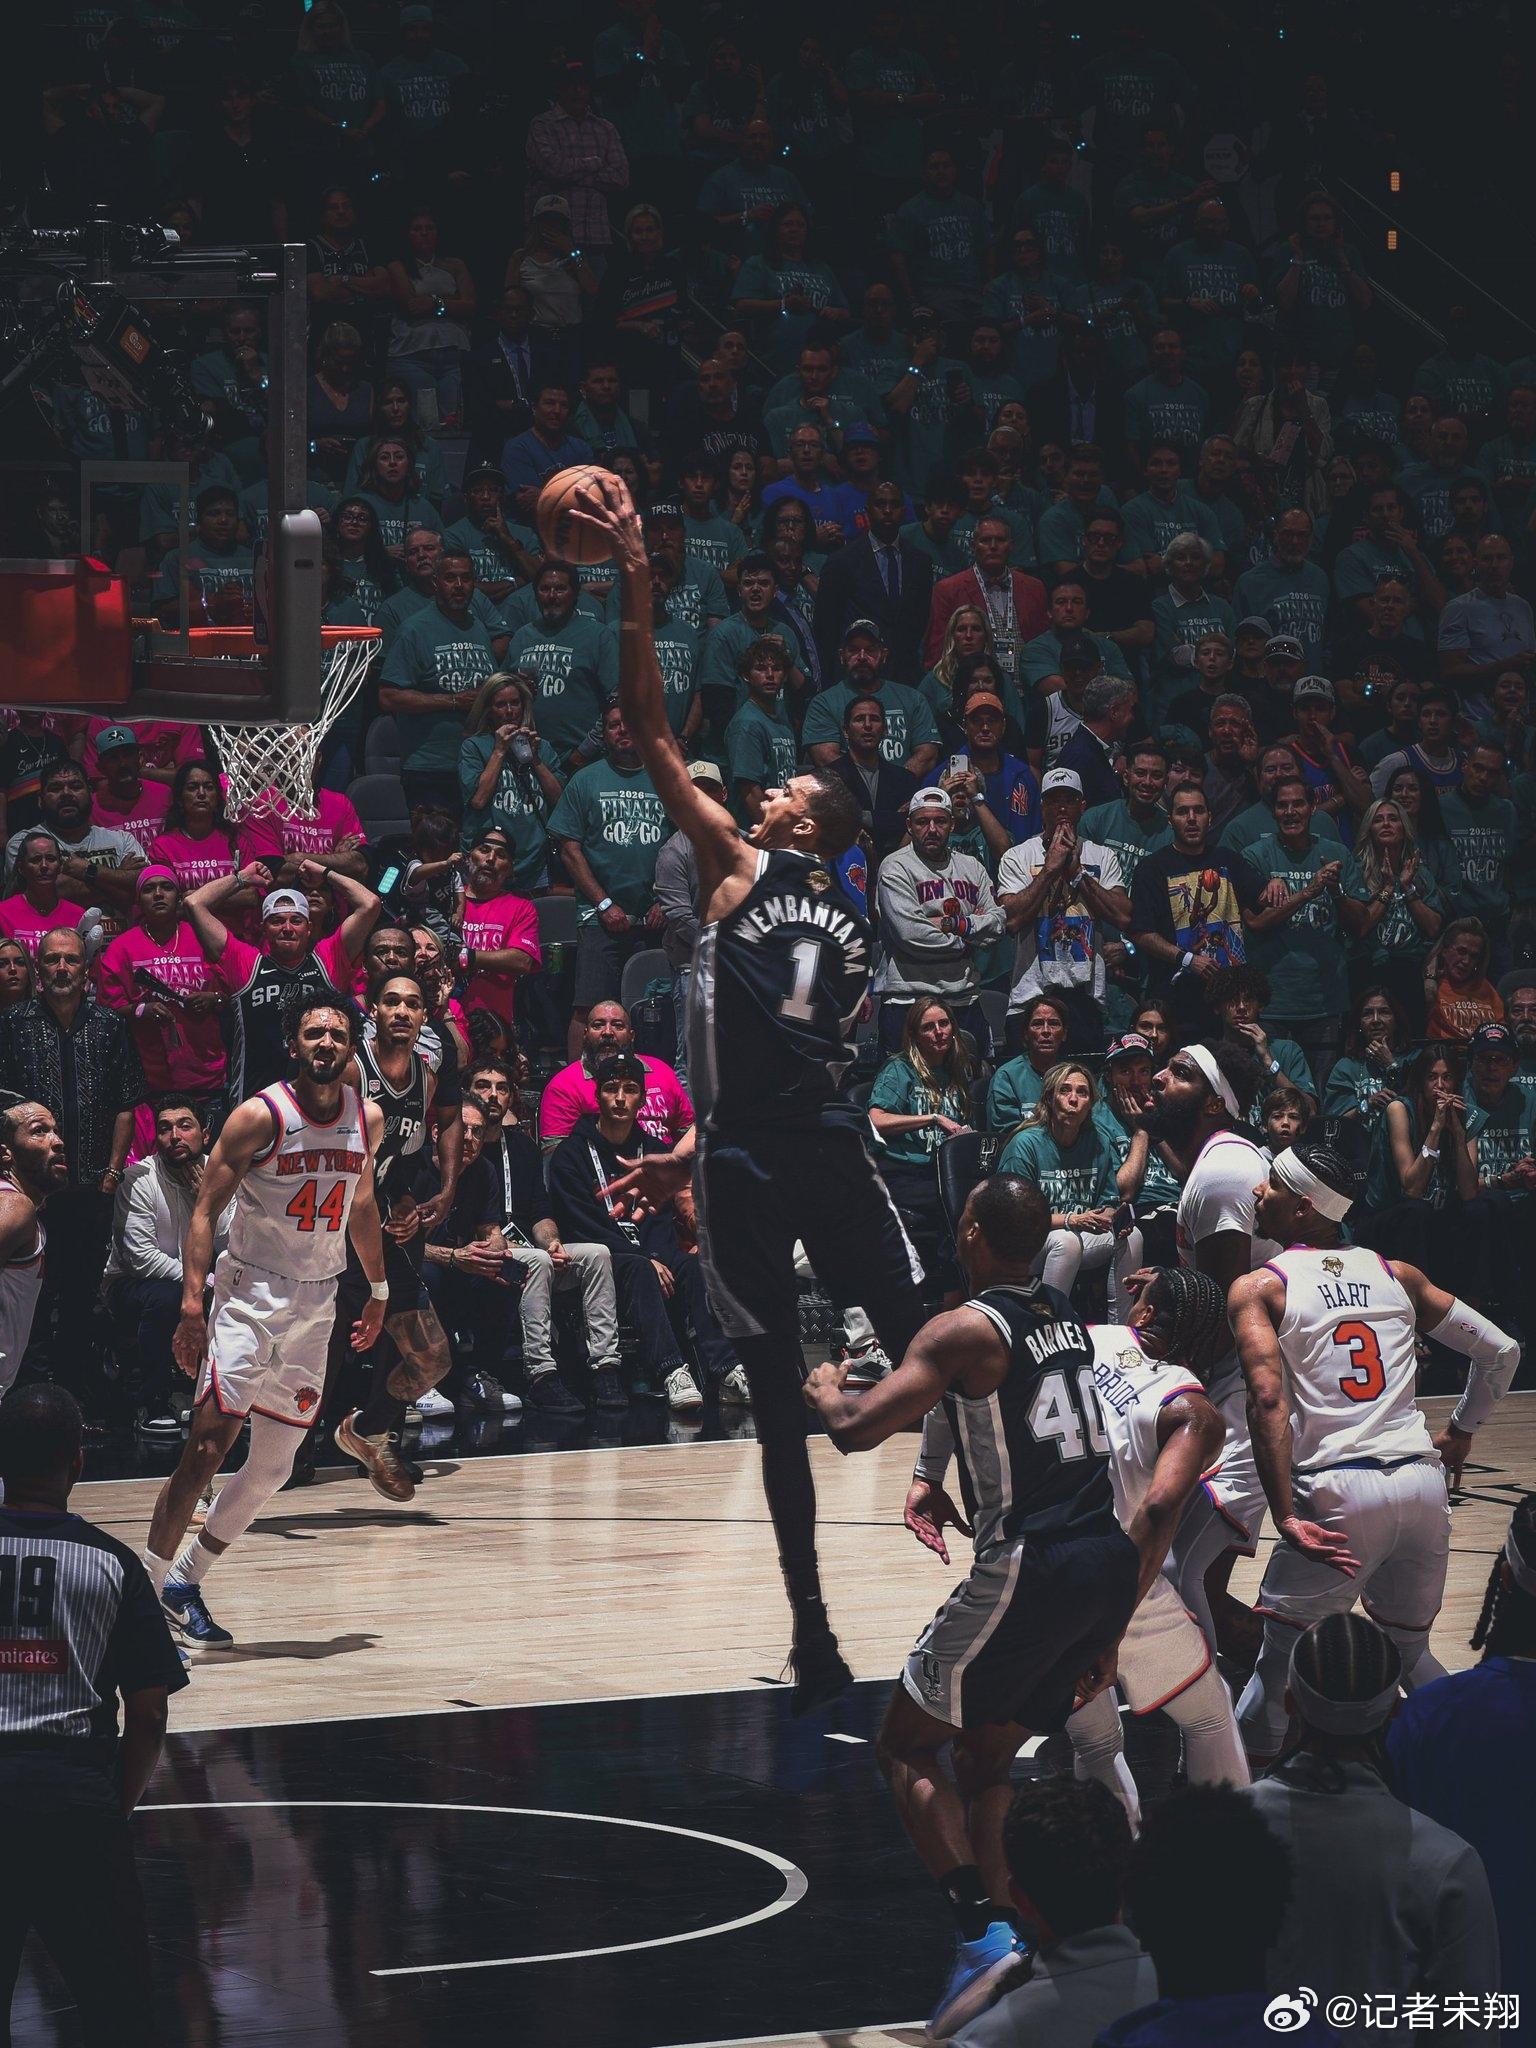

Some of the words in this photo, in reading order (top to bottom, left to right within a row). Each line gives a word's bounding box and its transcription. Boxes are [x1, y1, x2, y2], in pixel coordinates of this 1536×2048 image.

[690, 538, 712, 547] 2026
[452, 642, 473, 651] 2026
[534, 644, 555, 652] 2026
[434, 652, 494, 677] FINALS
[543, 675, 565, 698] GO
[883, 738, 903, 762] GO
[619, 790, 645, 799] 2026
[599, 798, 666, 826] FINALS
[124, 818, 151, 830] 2026
[602, 822, 626, 846] GO
[640, 822, 662, 846] GO
[1469, 827, 1492, 836] 2026
[1122, 843, 1145, 857] 2026
[190, 858, 218, 869] 2026
[1288, 871, 1312, 880] 2026
[733, 894, 867, 978] WEMBANYAMA
[153, 955, 181, 965] 2026
[148, 964, 206, 991] NALS
[780, 936, 822, 1024] 1
[1483, 1128, 1509, 1138] 2026
[276, 1150, 319, 1177] NEW
[319, 1148, 366, 1176] YORK
[1055, 1168, 1080, 1178] 2026
[286, 1179, 347, 1232] 44
[1317, 1282, 1371, 1310] HART
[1024, 1322, 1086, 1365] BARNES
[1332, 1319, 1387, 1403] 3
[1092, 1362, 1140, 1418] BRIDE
[0, 1648, 59, 1665] mirates
